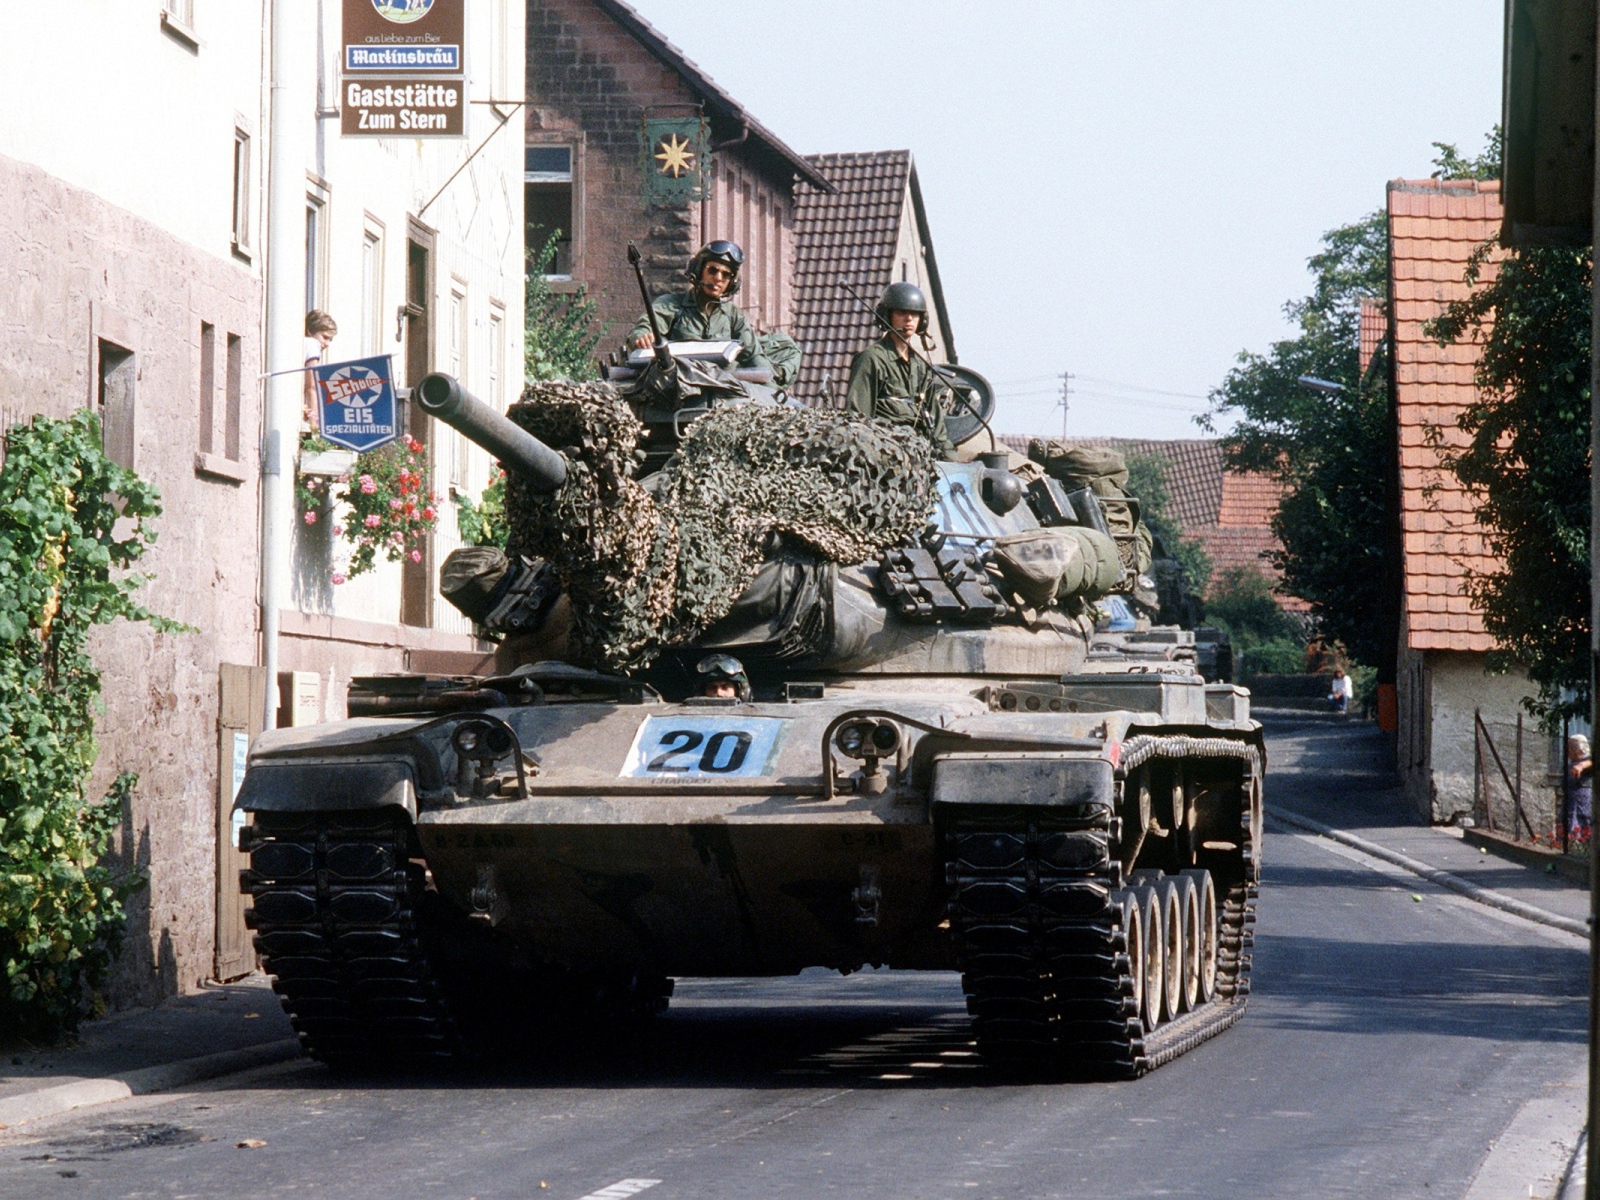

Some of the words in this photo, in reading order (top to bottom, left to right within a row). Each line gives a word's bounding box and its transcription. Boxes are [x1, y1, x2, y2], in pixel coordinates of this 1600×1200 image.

[352, 48, 454, 64] Martinsbräu
[347, 83, 458, 107] Gaststätte
[358, 109, 396, 129] Zum
[399, 109, 447, 129] Stern
[344, 408, 373, 423] EIS
[325, 423, 392, 434] SPEZIALITÄTEN
[646, 730, 753, 773] 20
